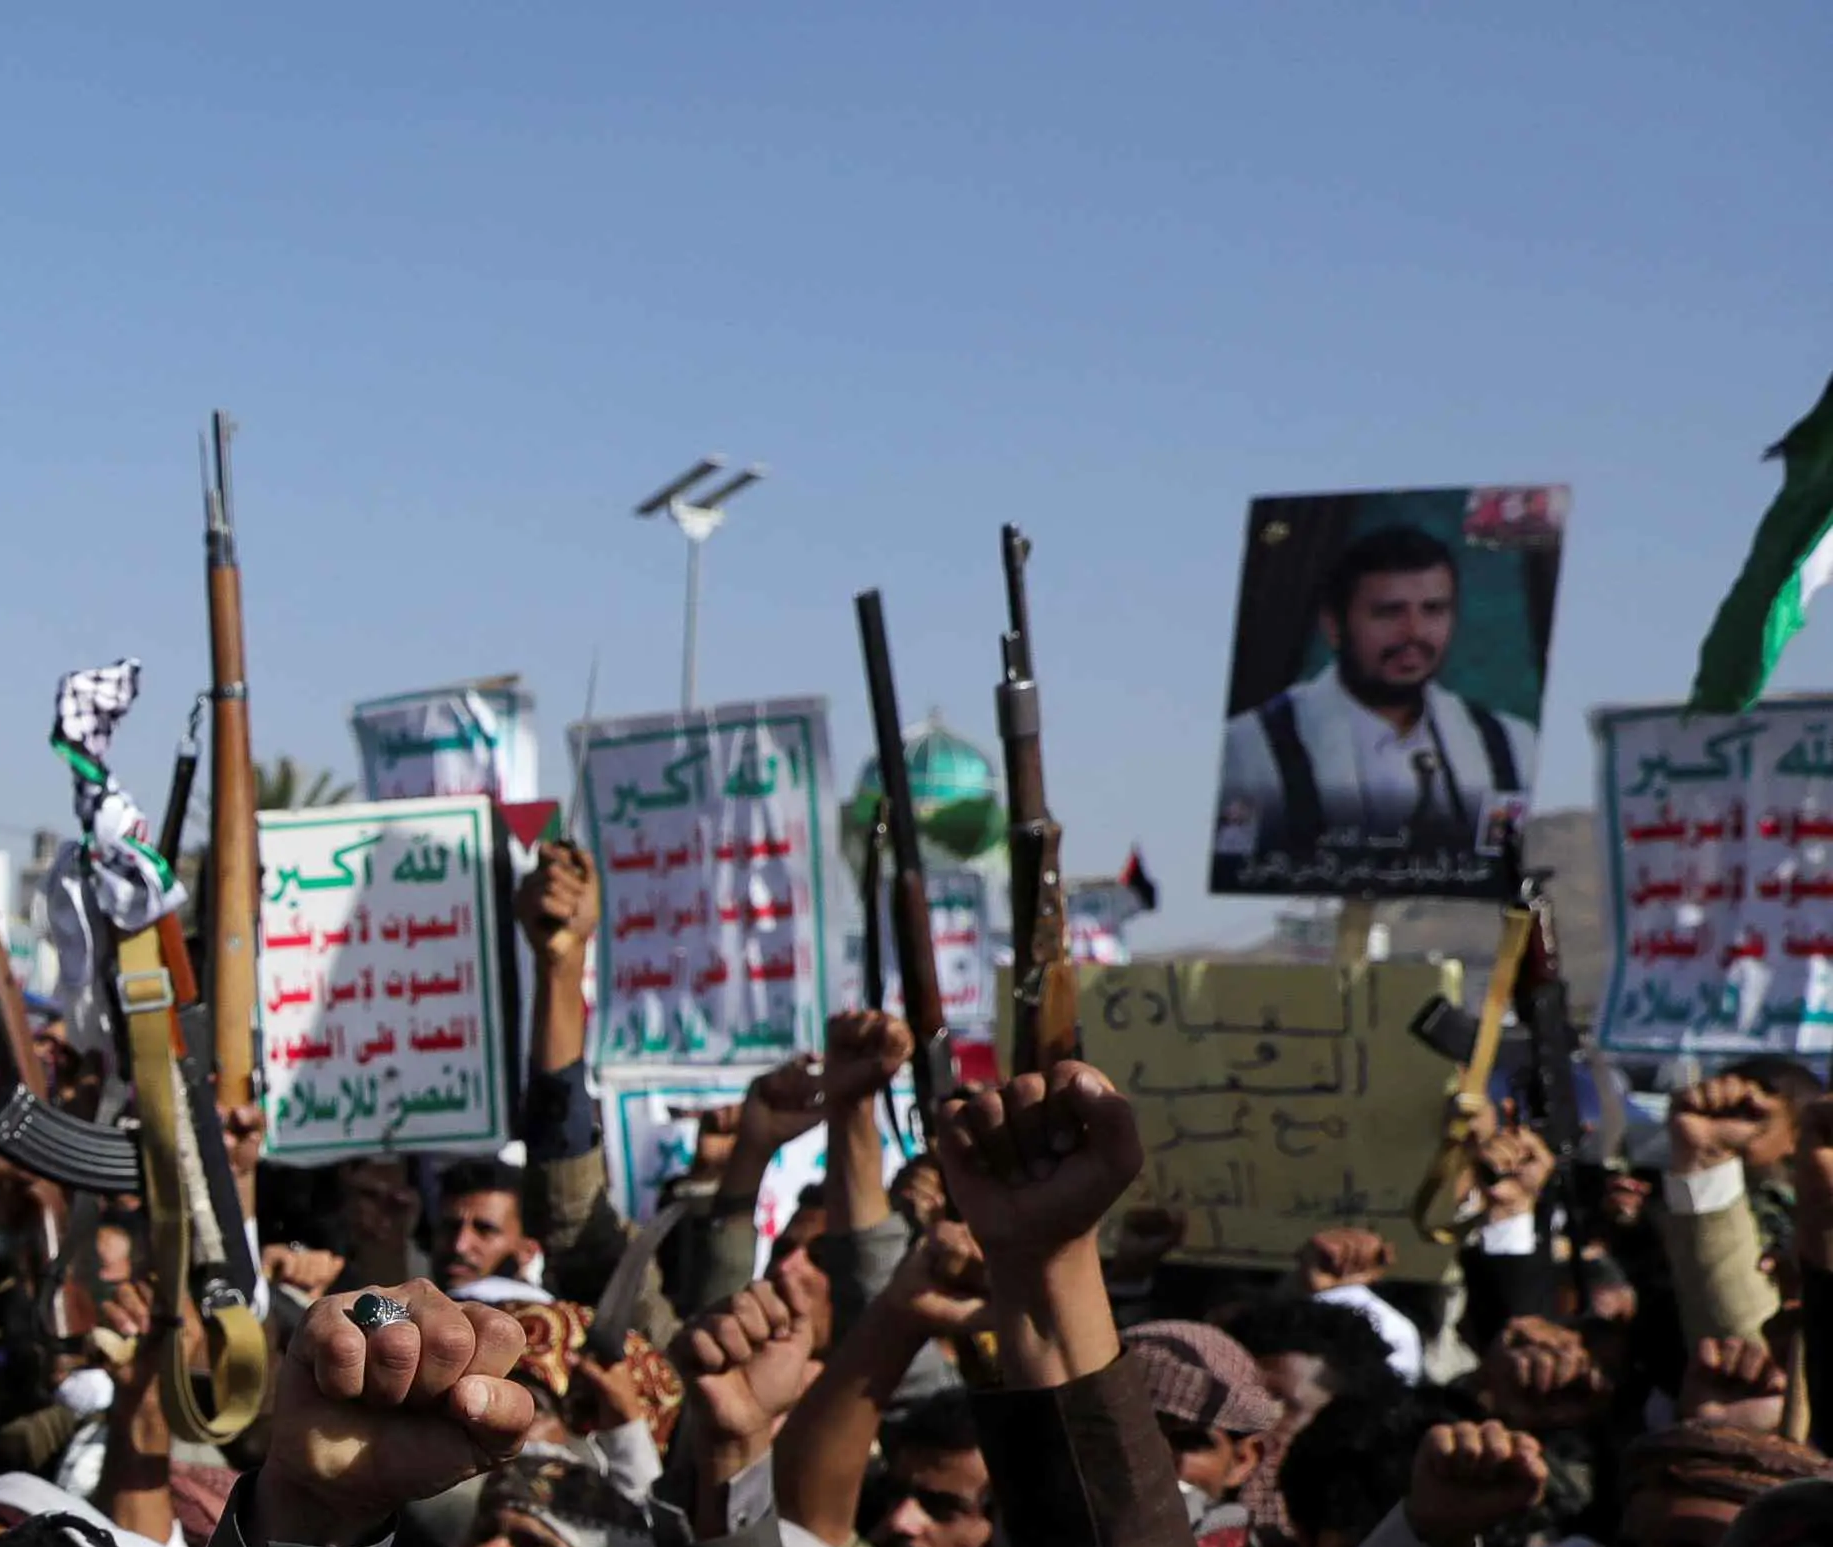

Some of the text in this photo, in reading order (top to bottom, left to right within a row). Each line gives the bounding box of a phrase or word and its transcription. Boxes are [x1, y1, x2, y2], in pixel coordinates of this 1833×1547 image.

[723, 742, 800, 797] الله
[269, 829, 470, 908] الله أكبر
[380, 904, 472, 949] الموت
[383, 962, 475, 1006] الموت
[355, 1025, 396, 1064] على
